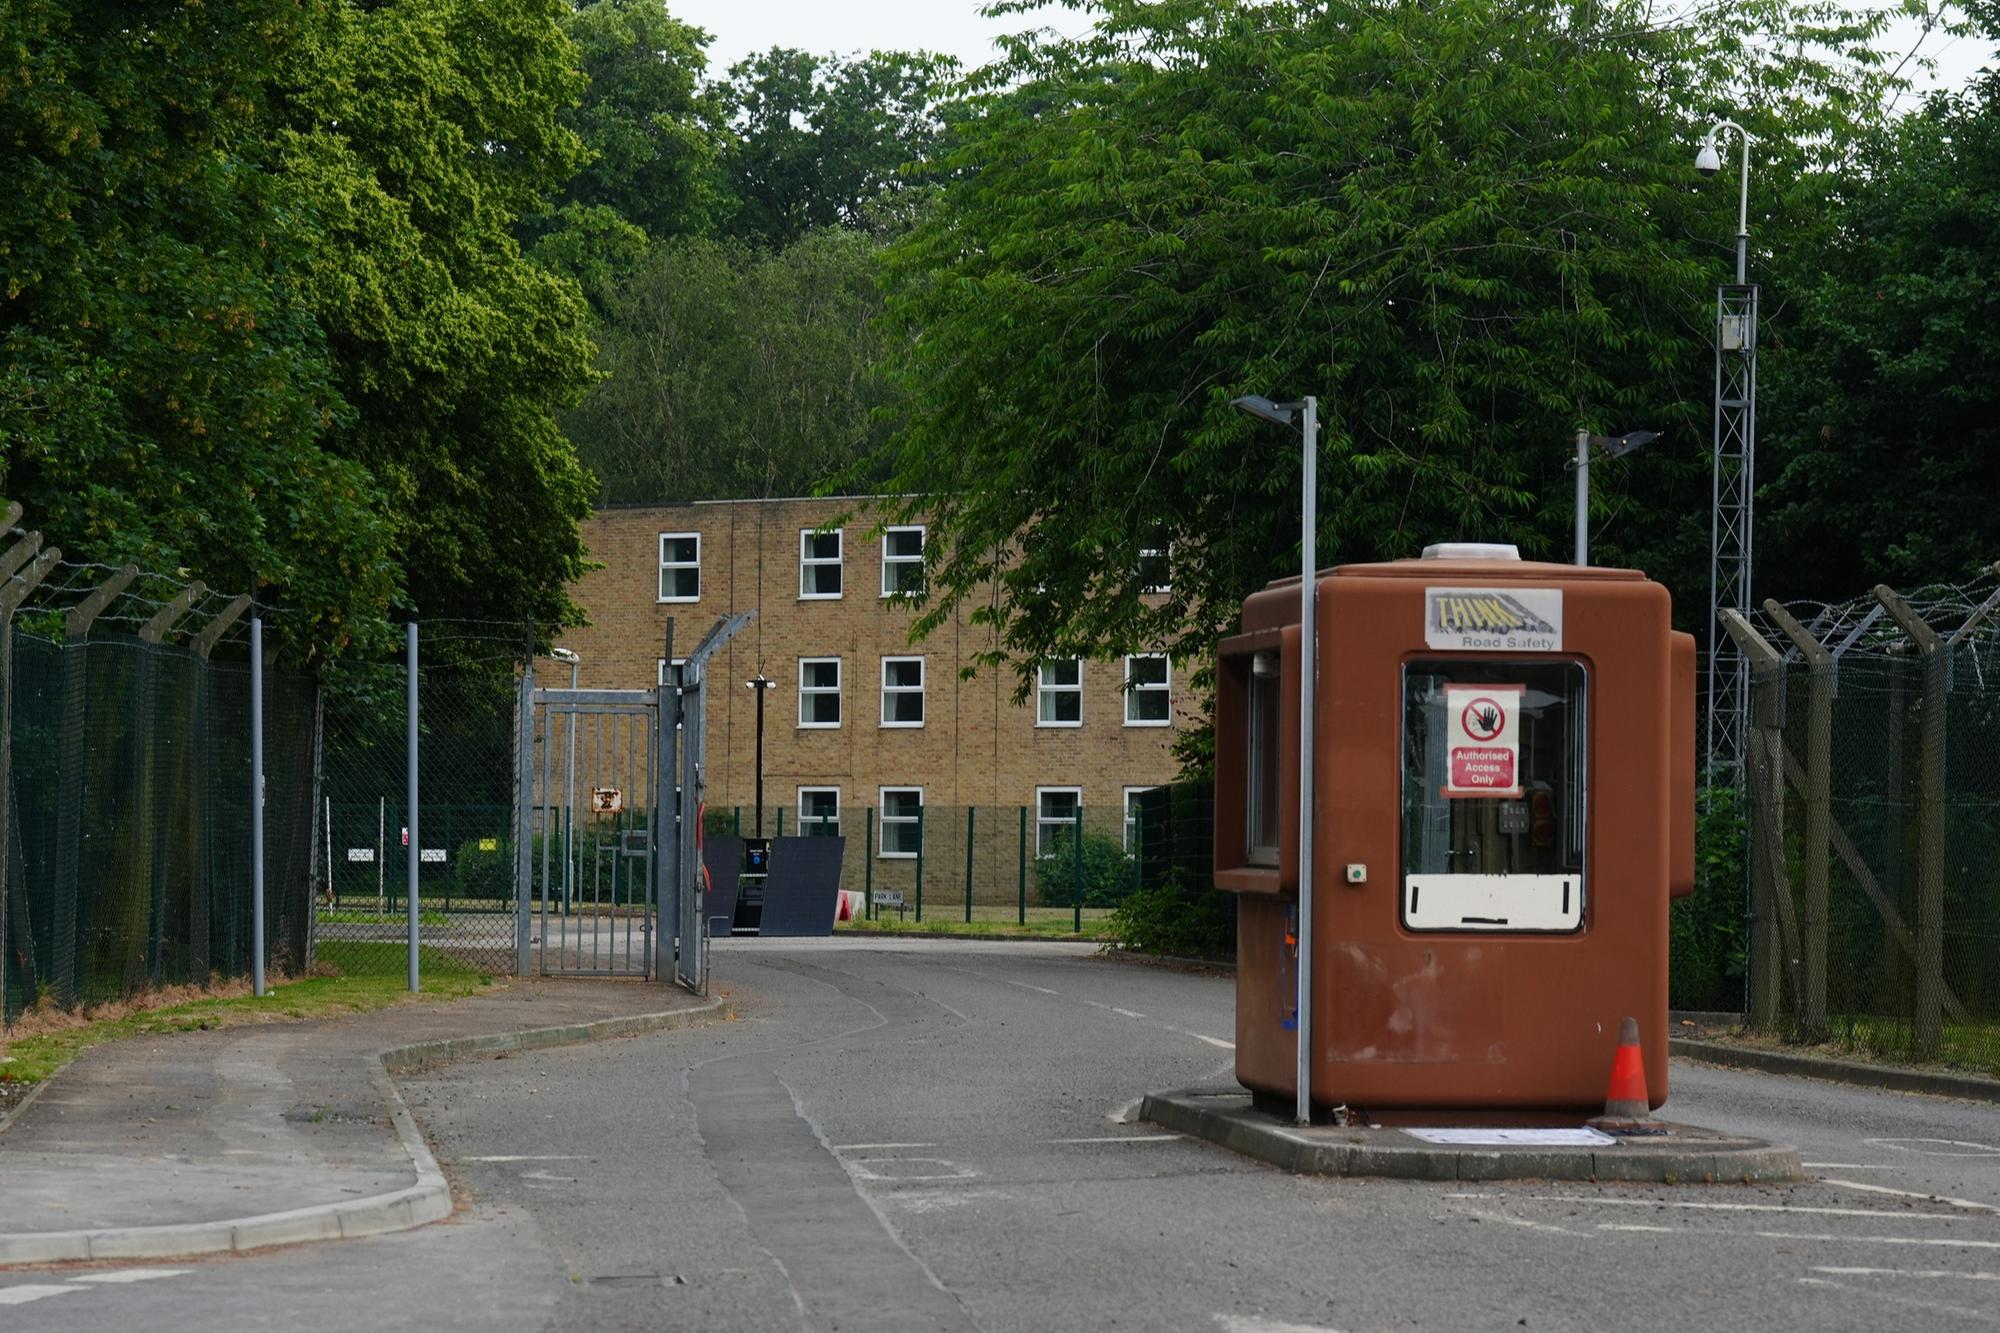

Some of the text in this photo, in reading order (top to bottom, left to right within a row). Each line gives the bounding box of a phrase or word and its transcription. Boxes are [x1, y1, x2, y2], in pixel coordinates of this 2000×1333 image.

[1462, 636, 1554, 650] Road Safety
[1456, 750, 1510, 761] Authorised
[1465, 762, 1501, 772] Access
[1471, 774, 1495, 786] Only
